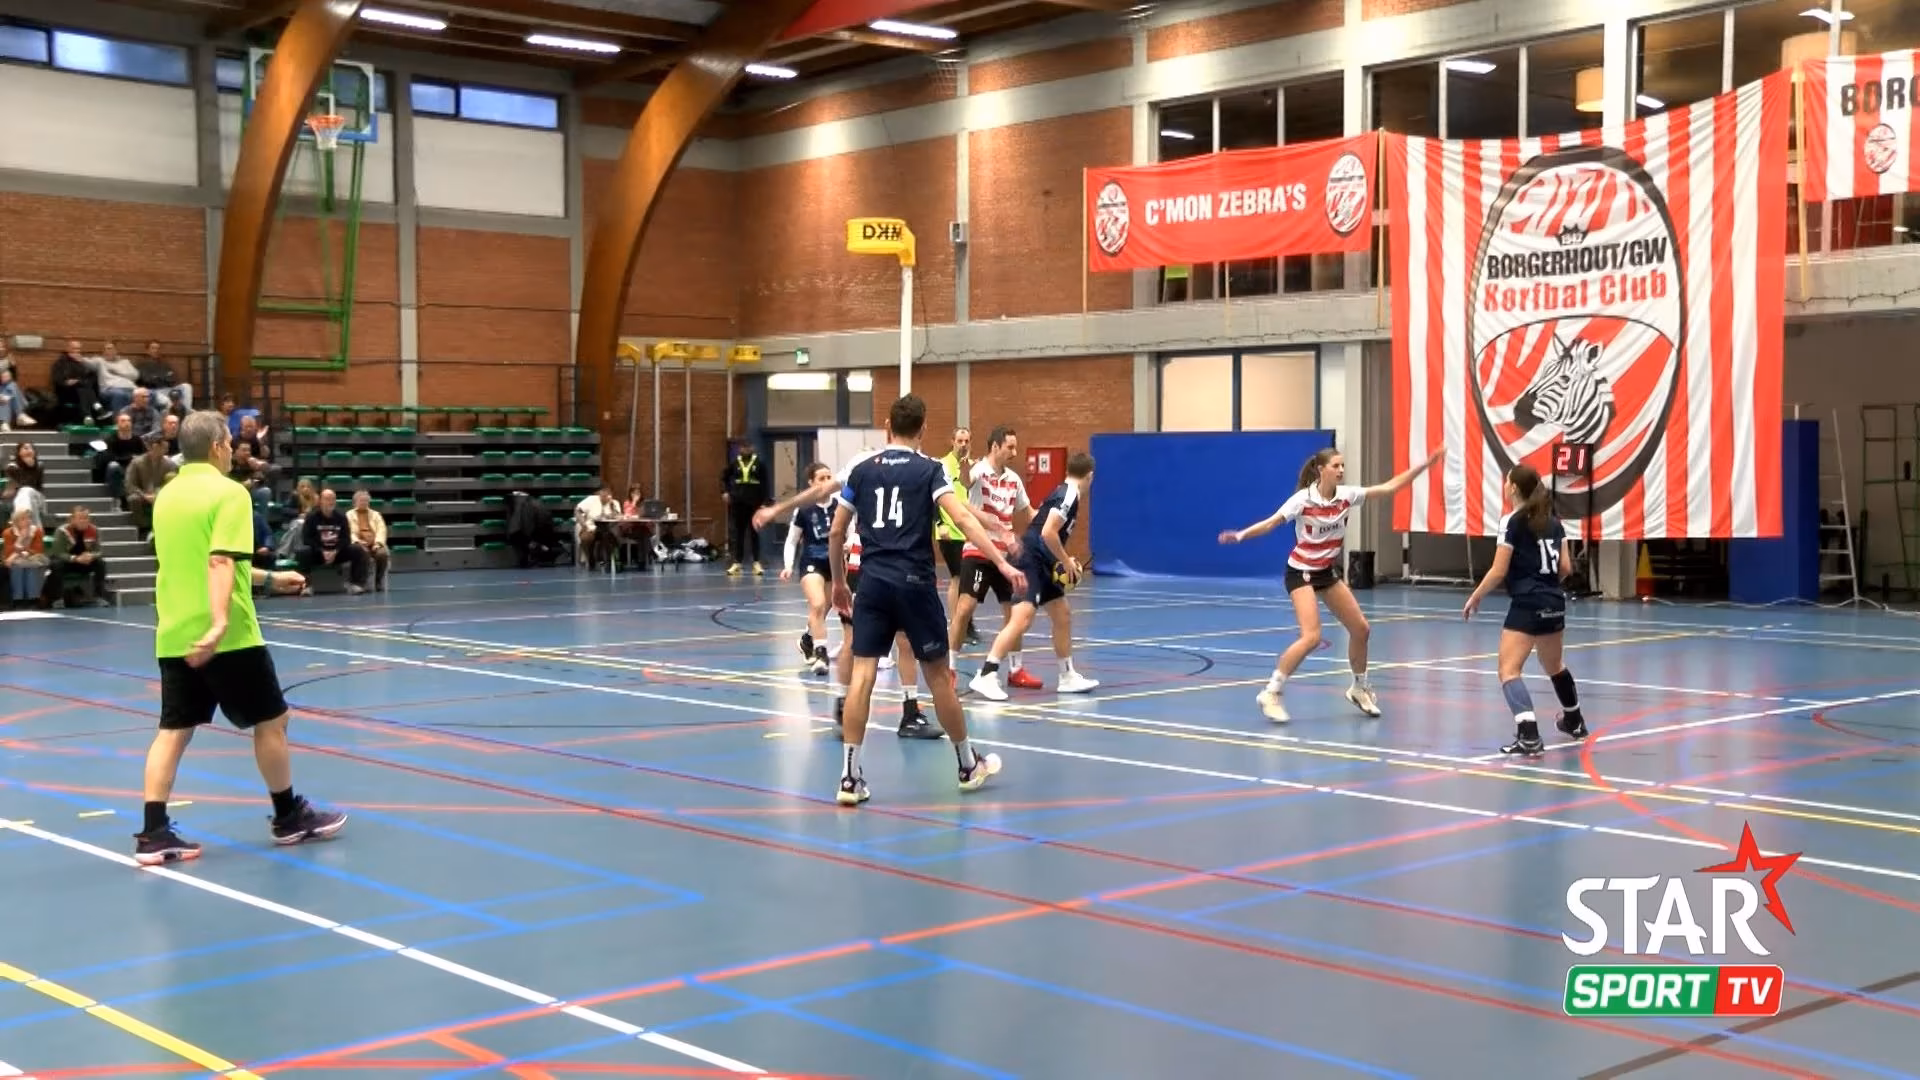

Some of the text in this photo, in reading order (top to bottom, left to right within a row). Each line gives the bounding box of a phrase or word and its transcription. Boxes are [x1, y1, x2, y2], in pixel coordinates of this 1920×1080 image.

[1145, 183, 1307, 226] C'MON ZEBRA'S
[1487, 237, 1668, 280] BORGERHOUT/GW
[1484, 269, 1667, 312] Korfbal Club
[1557, 447, 1585, 471] 21
[872, 486, 903, 528] 14
[1537, 539, 1559, 575] 15
